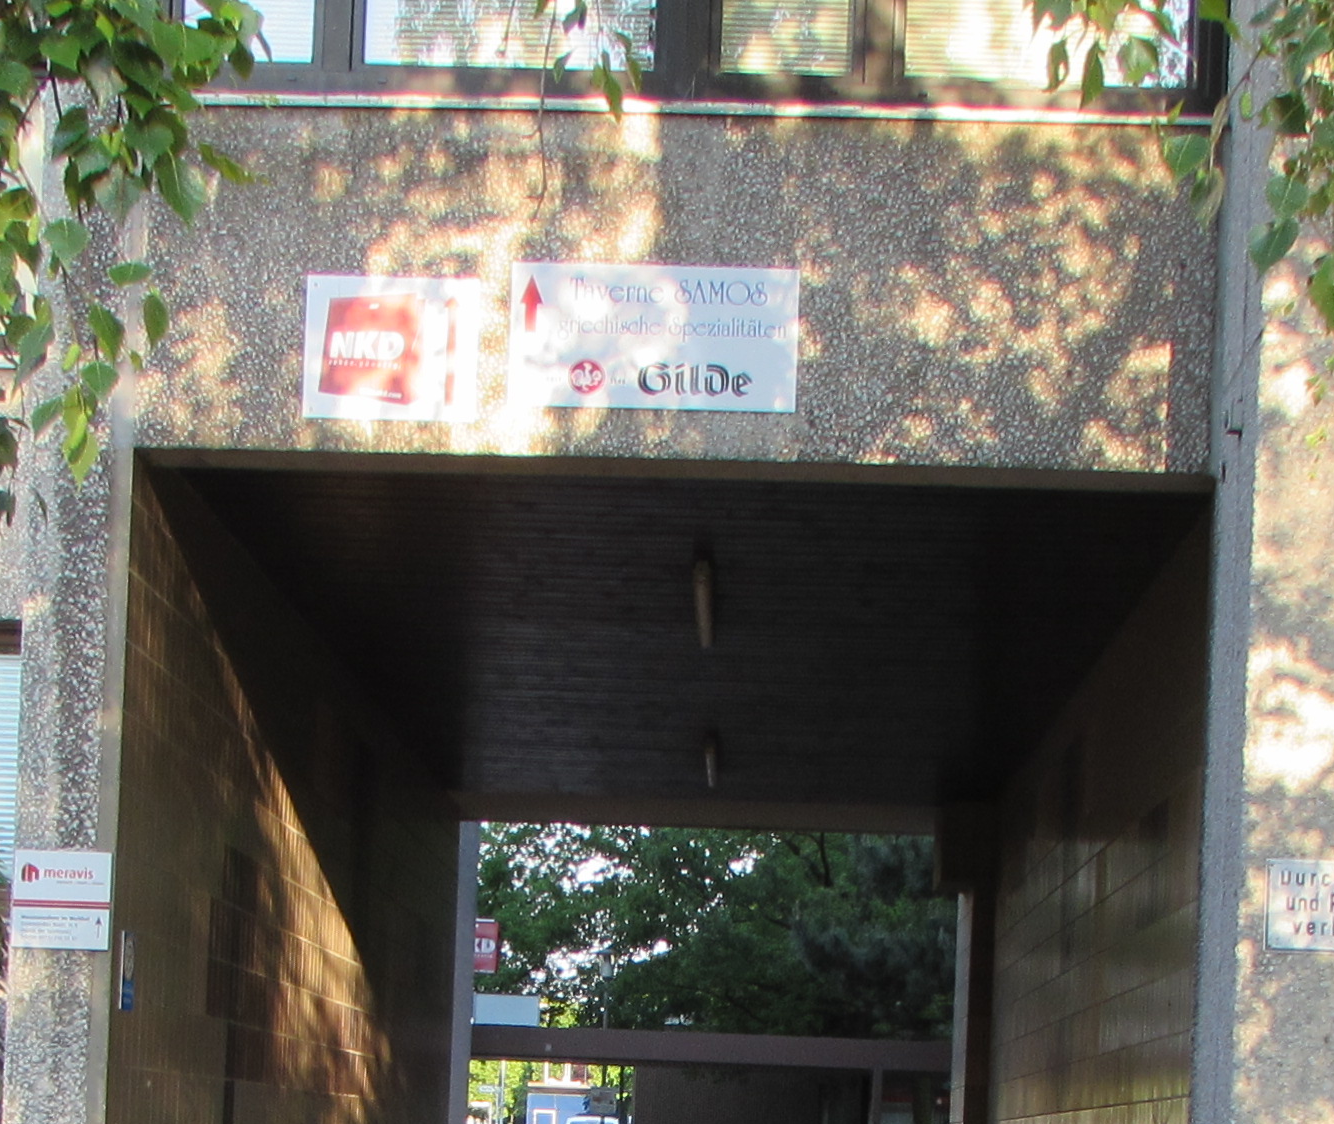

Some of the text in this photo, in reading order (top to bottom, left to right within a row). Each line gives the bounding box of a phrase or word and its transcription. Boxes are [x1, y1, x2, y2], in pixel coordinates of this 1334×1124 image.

[674, 278, 769, 307] SAMOS
[557, 314, 788, 343] griechische Spezialitäten
[328, 330, 406, 361] NKD
[43, 867, 94, 880] meravis
[1285, 893, 1319, 913] und
